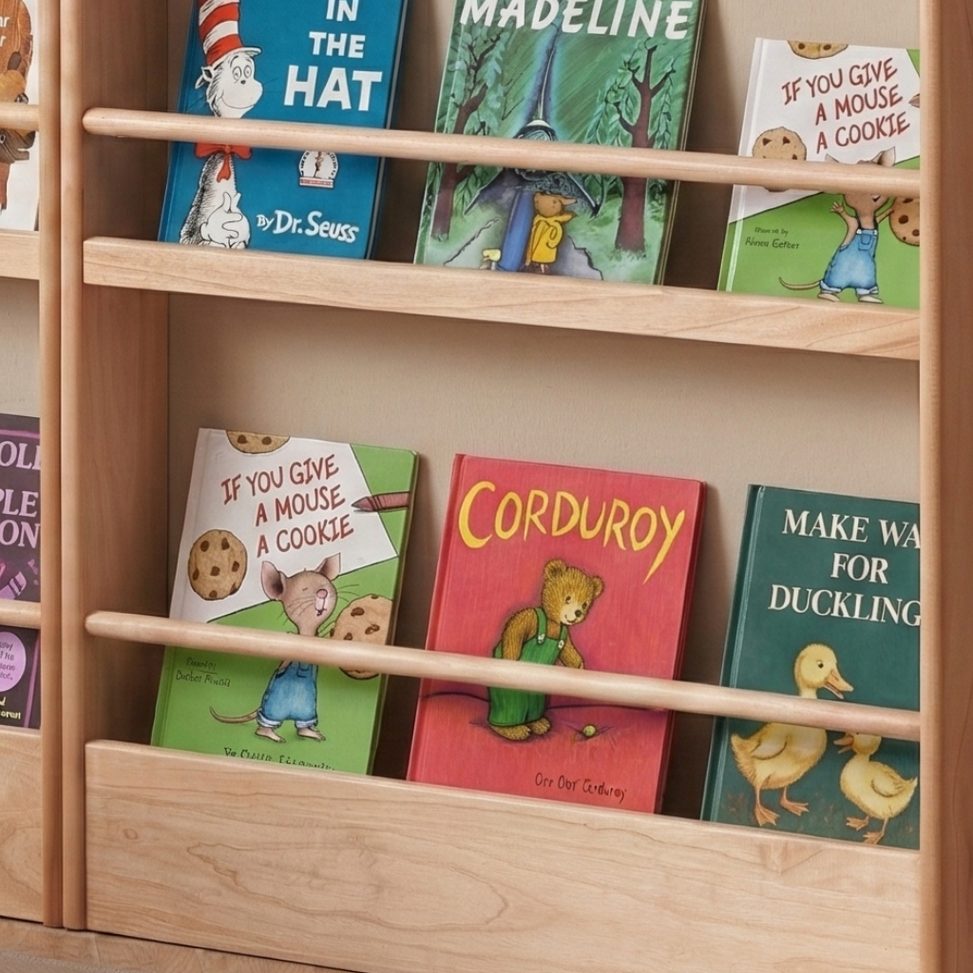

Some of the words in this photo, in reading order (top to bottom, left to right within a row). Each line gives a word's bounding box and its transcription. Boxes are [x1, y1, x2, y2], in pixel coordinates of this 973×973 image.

[309, 31, 365, 59] THE
[283, 65, 383, 111] HAT
[781, 77, 803, 105] IF
[805, 69, 843, 97] YOU
[849, 57, 897, 88] GIVE
[815, 103, 827, 125] A
[835, 85, 903, 121] MOUSE
[816, 131, 828, 154] A
[835, 111, 911, 147] COOKIE
[256, 214, 275, 231] By
[273, 209, 303, 235] Dr.
[305, 211, 359, 243] Seuss
[221, 473, 242, 505] IF
[245, 466, 284, 497] YOU
[289, 454, 340, 485] GIVE
[255, 503, 268, 527] A
[275, 485, 346, 521] MOUSE
[256, 534, 269, 558] A
[276, 513, 355, 553] COOKIE
[458, 481, 685, 585] CORDUROY
[782, 508, 869, 543] MAKE
[879, 519, 921, 549] WA
[830, 552, 889, 585] FOR
[768, 584, 921, 627] DUCKLING
